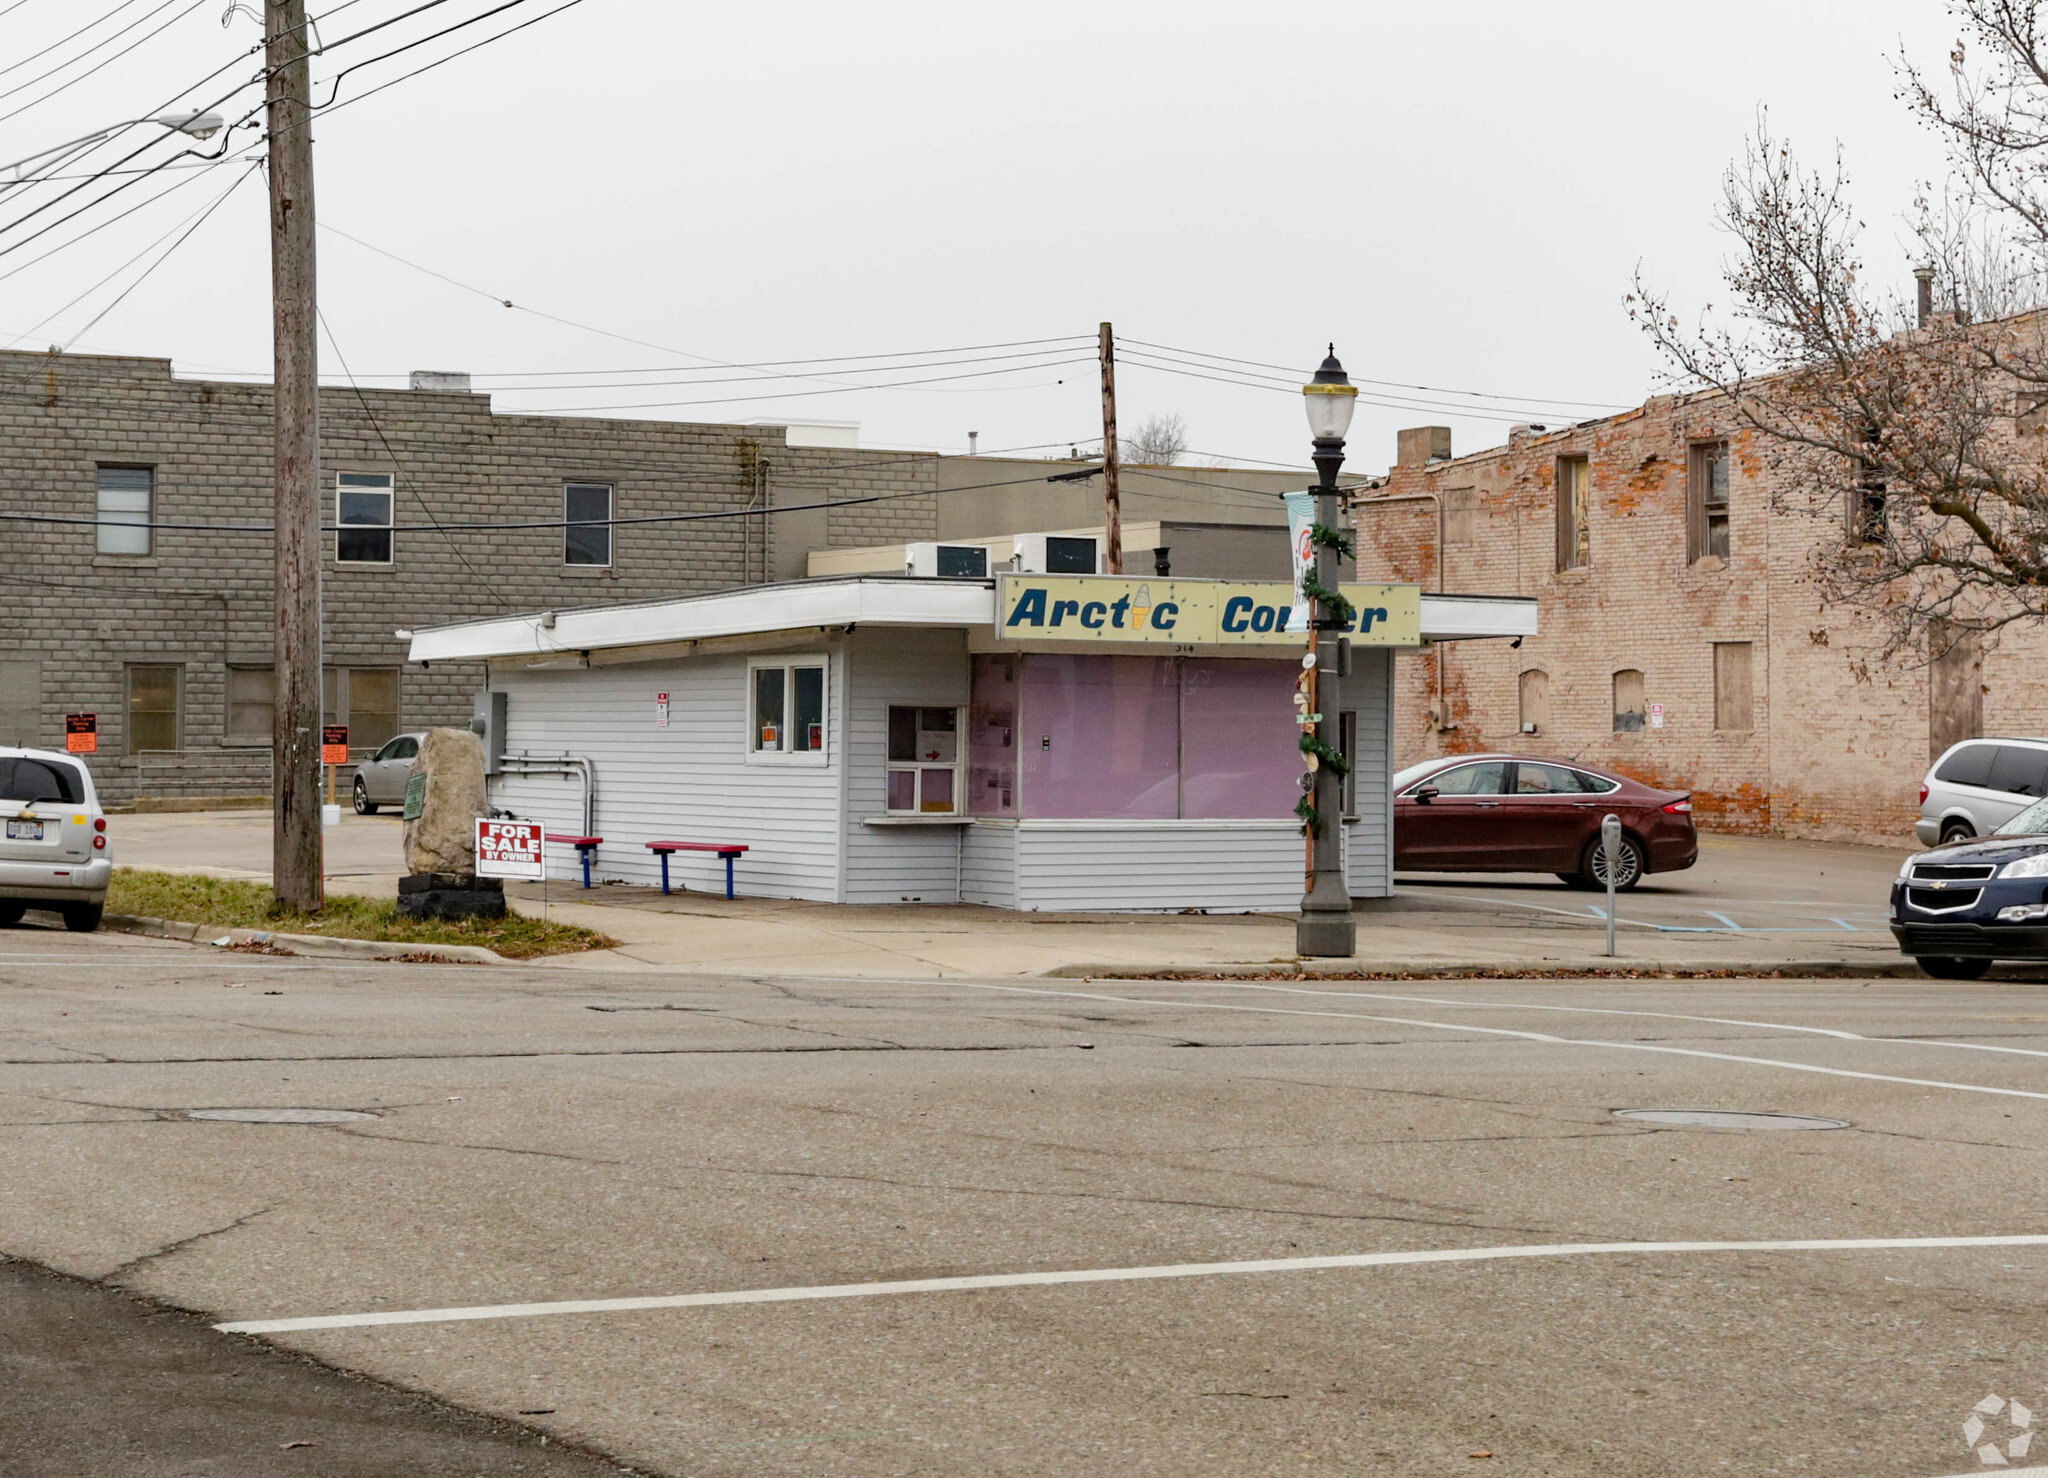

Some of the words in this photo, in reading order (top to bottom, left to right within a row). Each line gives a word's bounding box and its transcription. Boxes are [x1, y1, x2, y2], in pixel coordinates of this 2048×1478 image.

[1222, 596, 1388, 633] Corer
[489, 824, 531, 839] FOR
[481, 836, 540, 854] SALE
[486, 850, 499, 860] BY
[501, 851, 535, 862] OWNER
